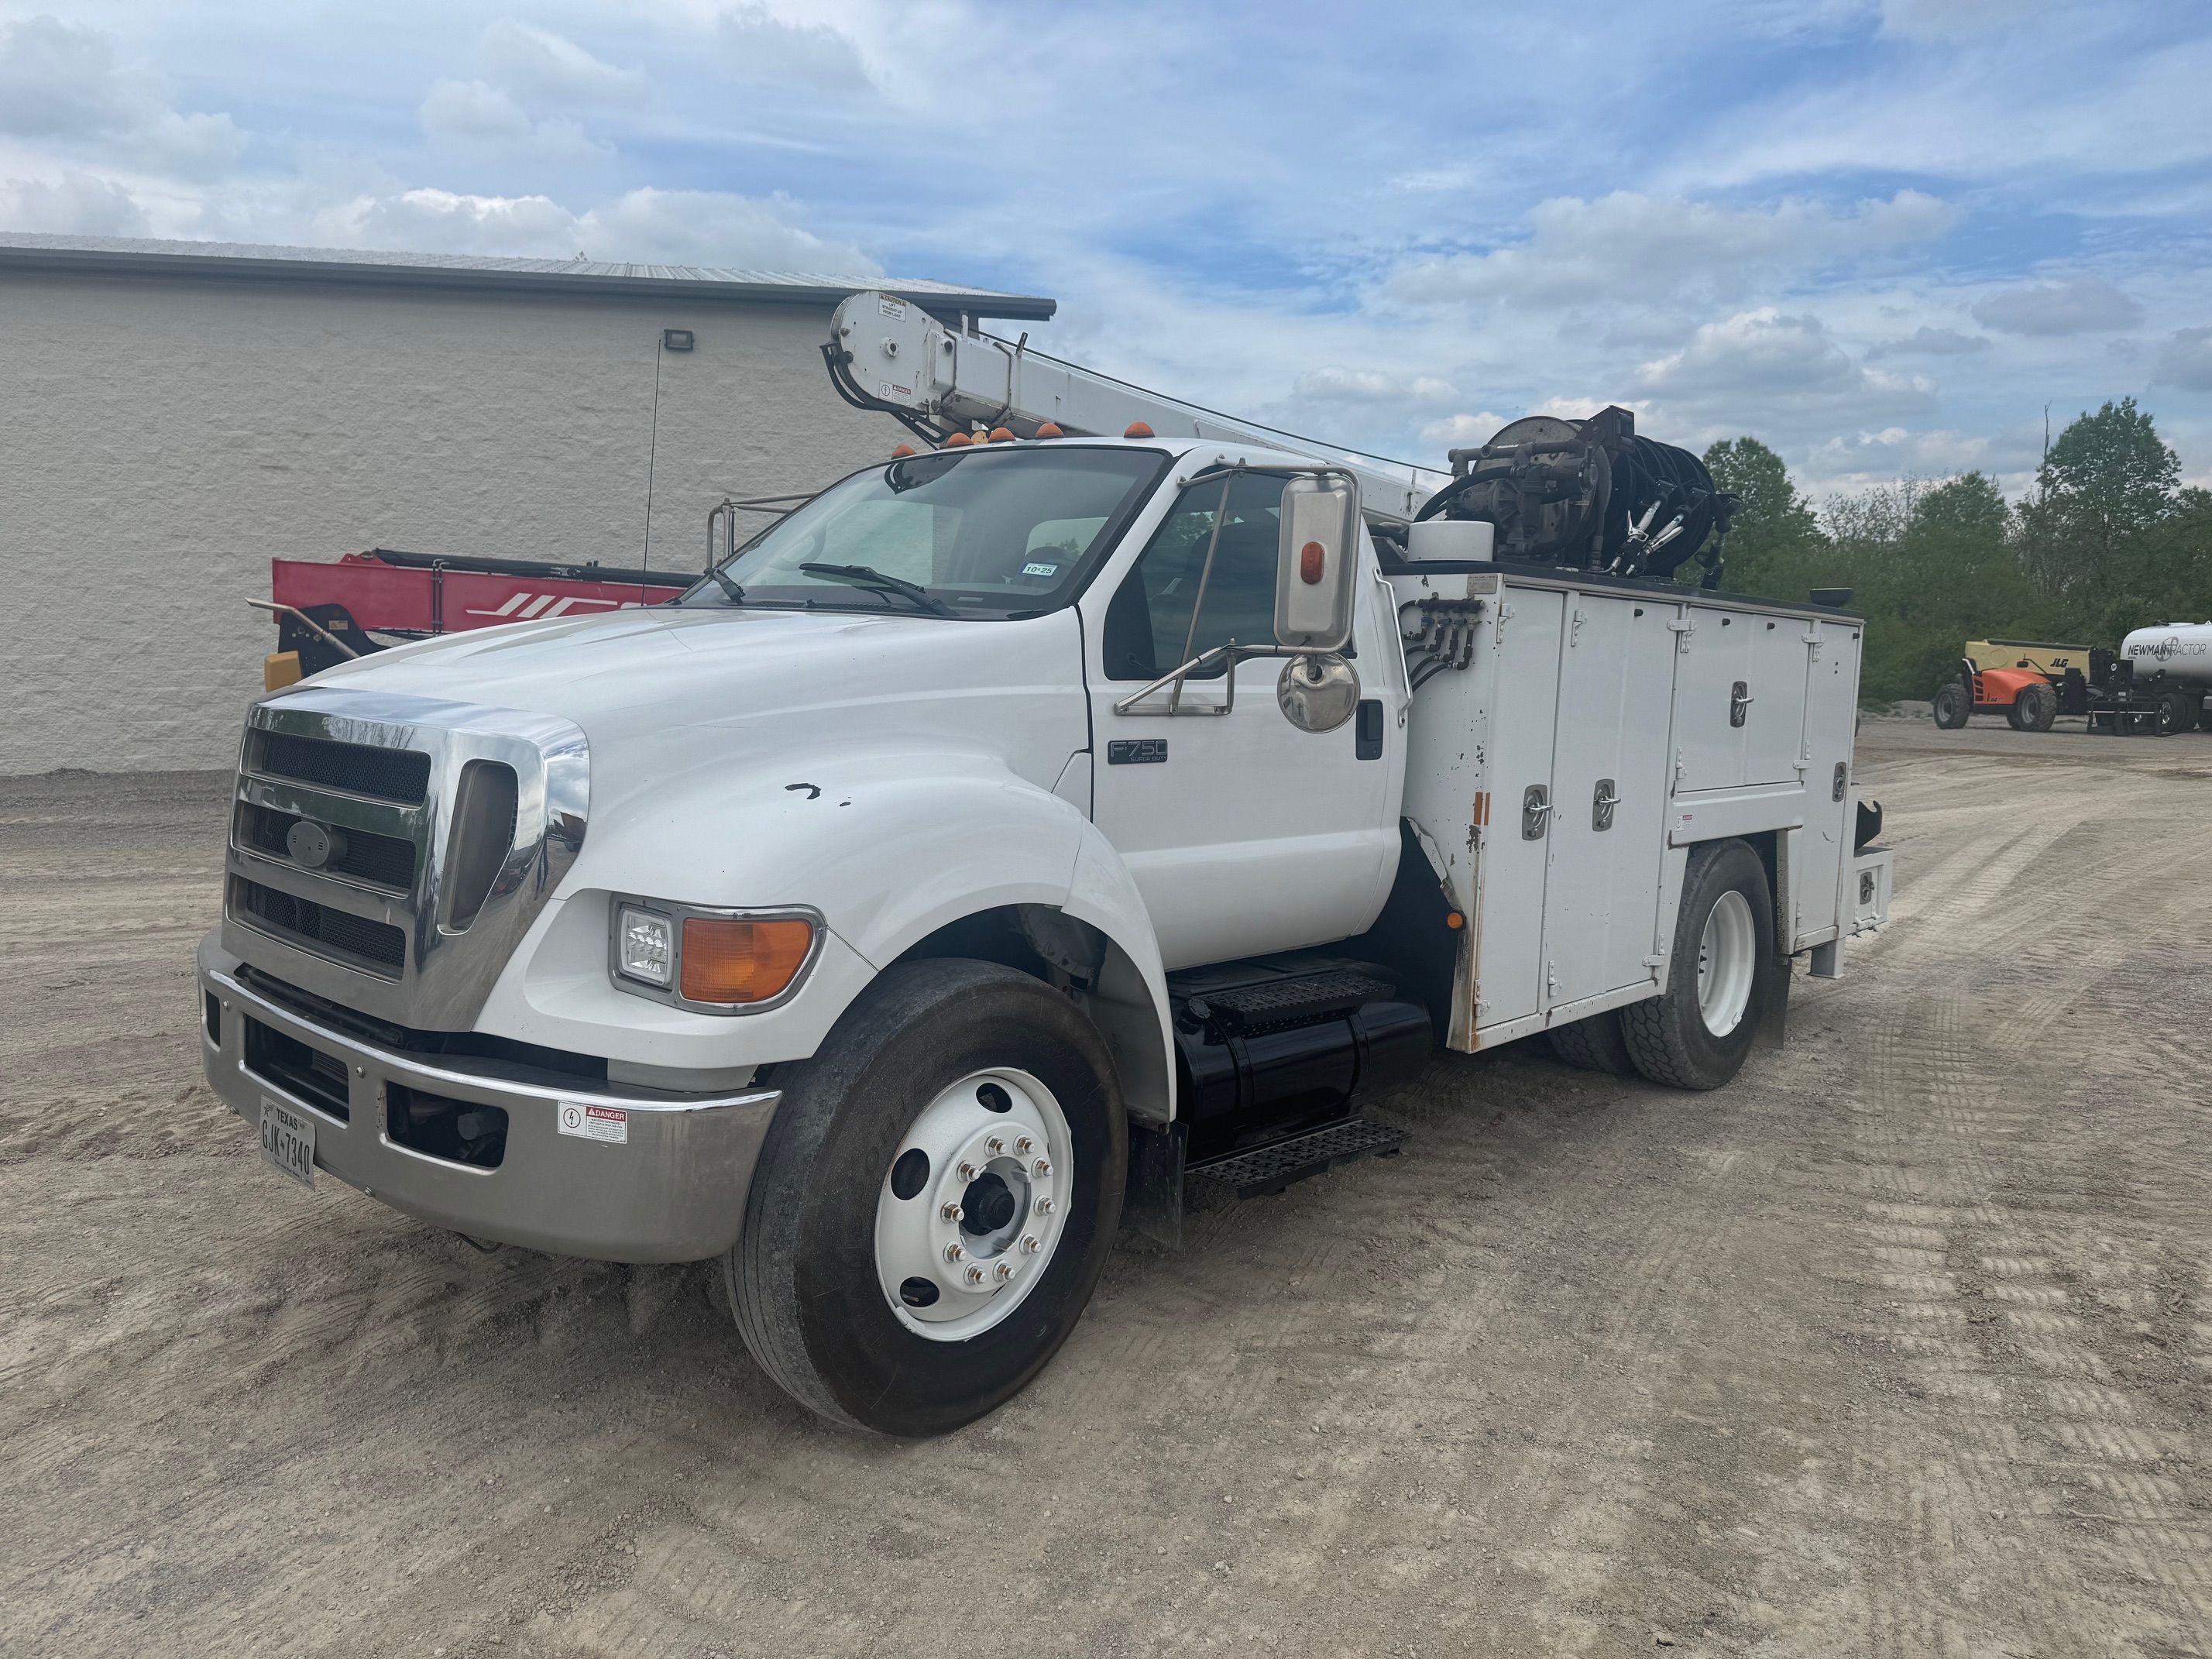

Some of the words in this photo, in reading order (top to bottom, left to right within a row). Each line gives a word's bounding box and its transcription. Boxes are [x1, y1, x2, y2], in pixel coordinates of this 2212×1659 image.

[884, 295, 902, 305] CAUTION
[2128, 644, 2166, 656] NEWMAN
[2167, 644, 2207, 656] TRACTOR
[2049, 658, 2069, 668] JLG
[1111, 740, 1167, 757] F-750
[276, 1108, 297, 1131] TEXAS
[596, 1110, 625, 1120] DANGER
